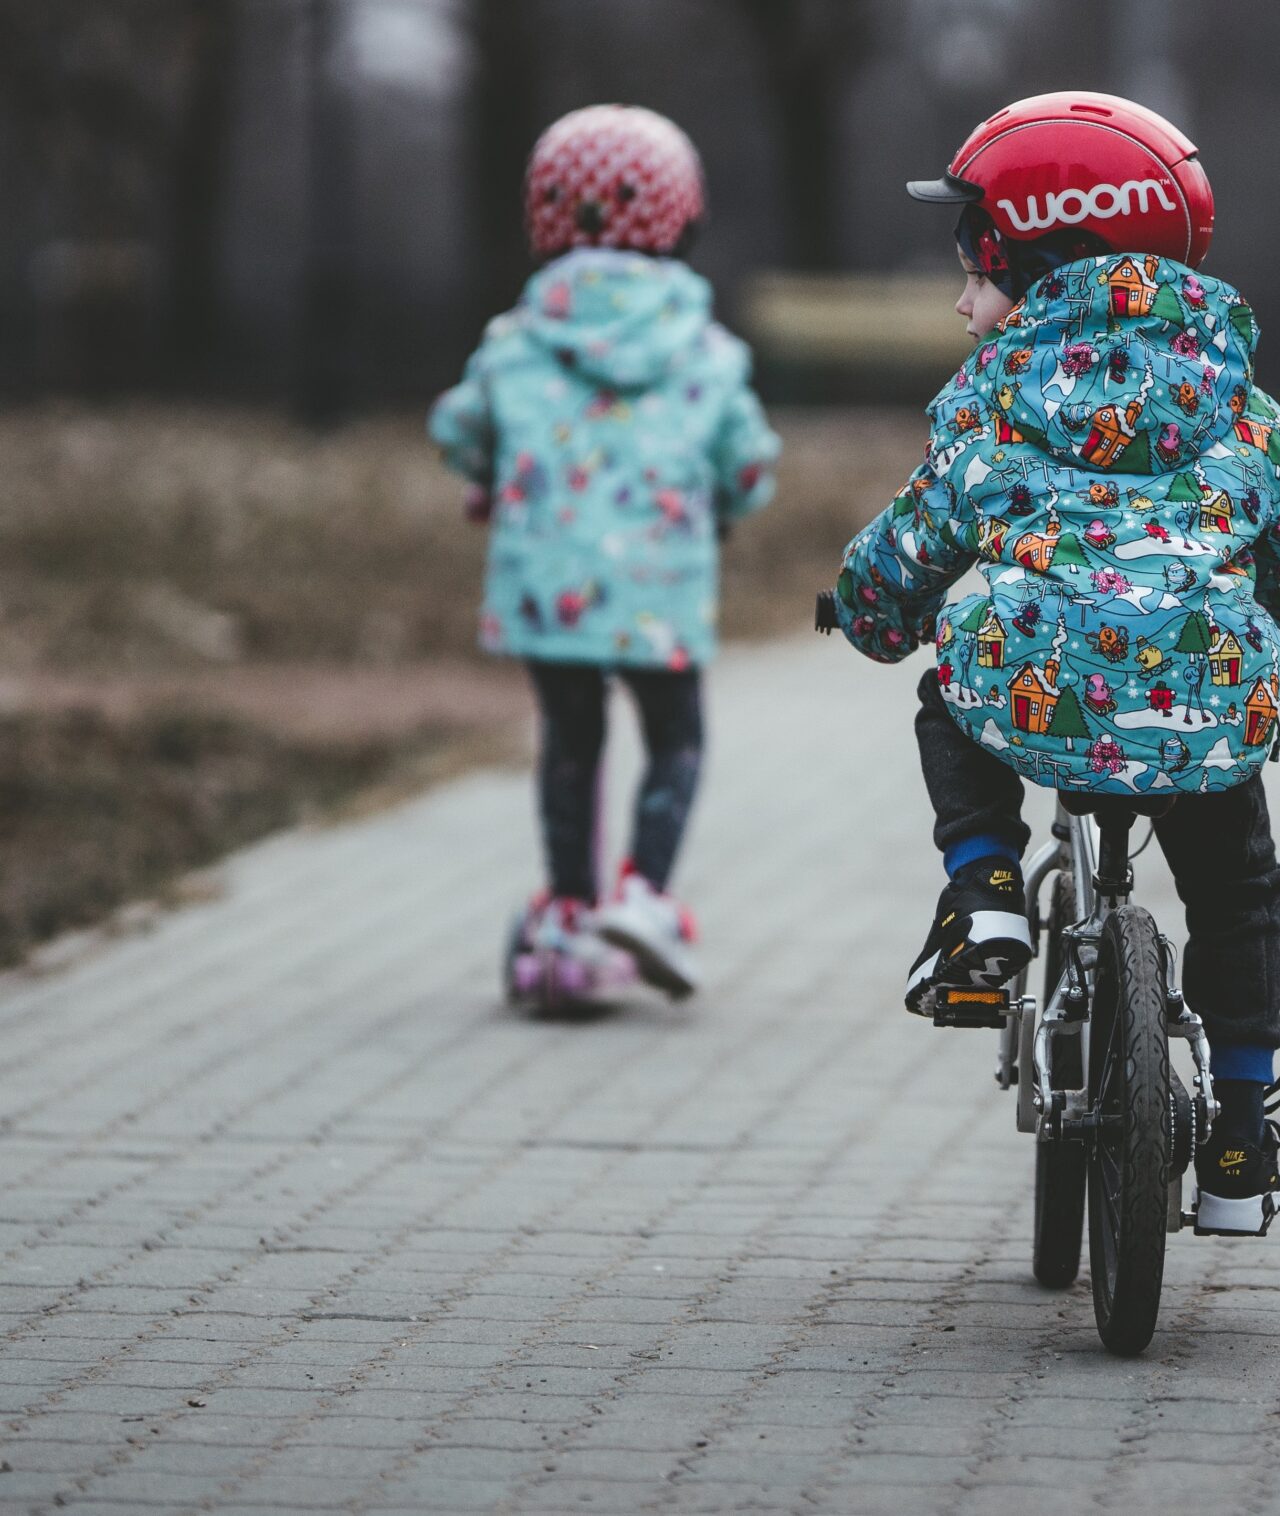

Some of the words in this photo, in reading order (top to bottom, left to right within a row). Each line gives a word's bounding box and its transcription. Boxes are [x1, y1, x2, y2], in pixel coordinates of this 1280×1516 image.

[997, 179, 1176, 231] woom
[993, 869, 1012, 879] NIKE
[1223, 1150, 1245, 1160] NIKE
